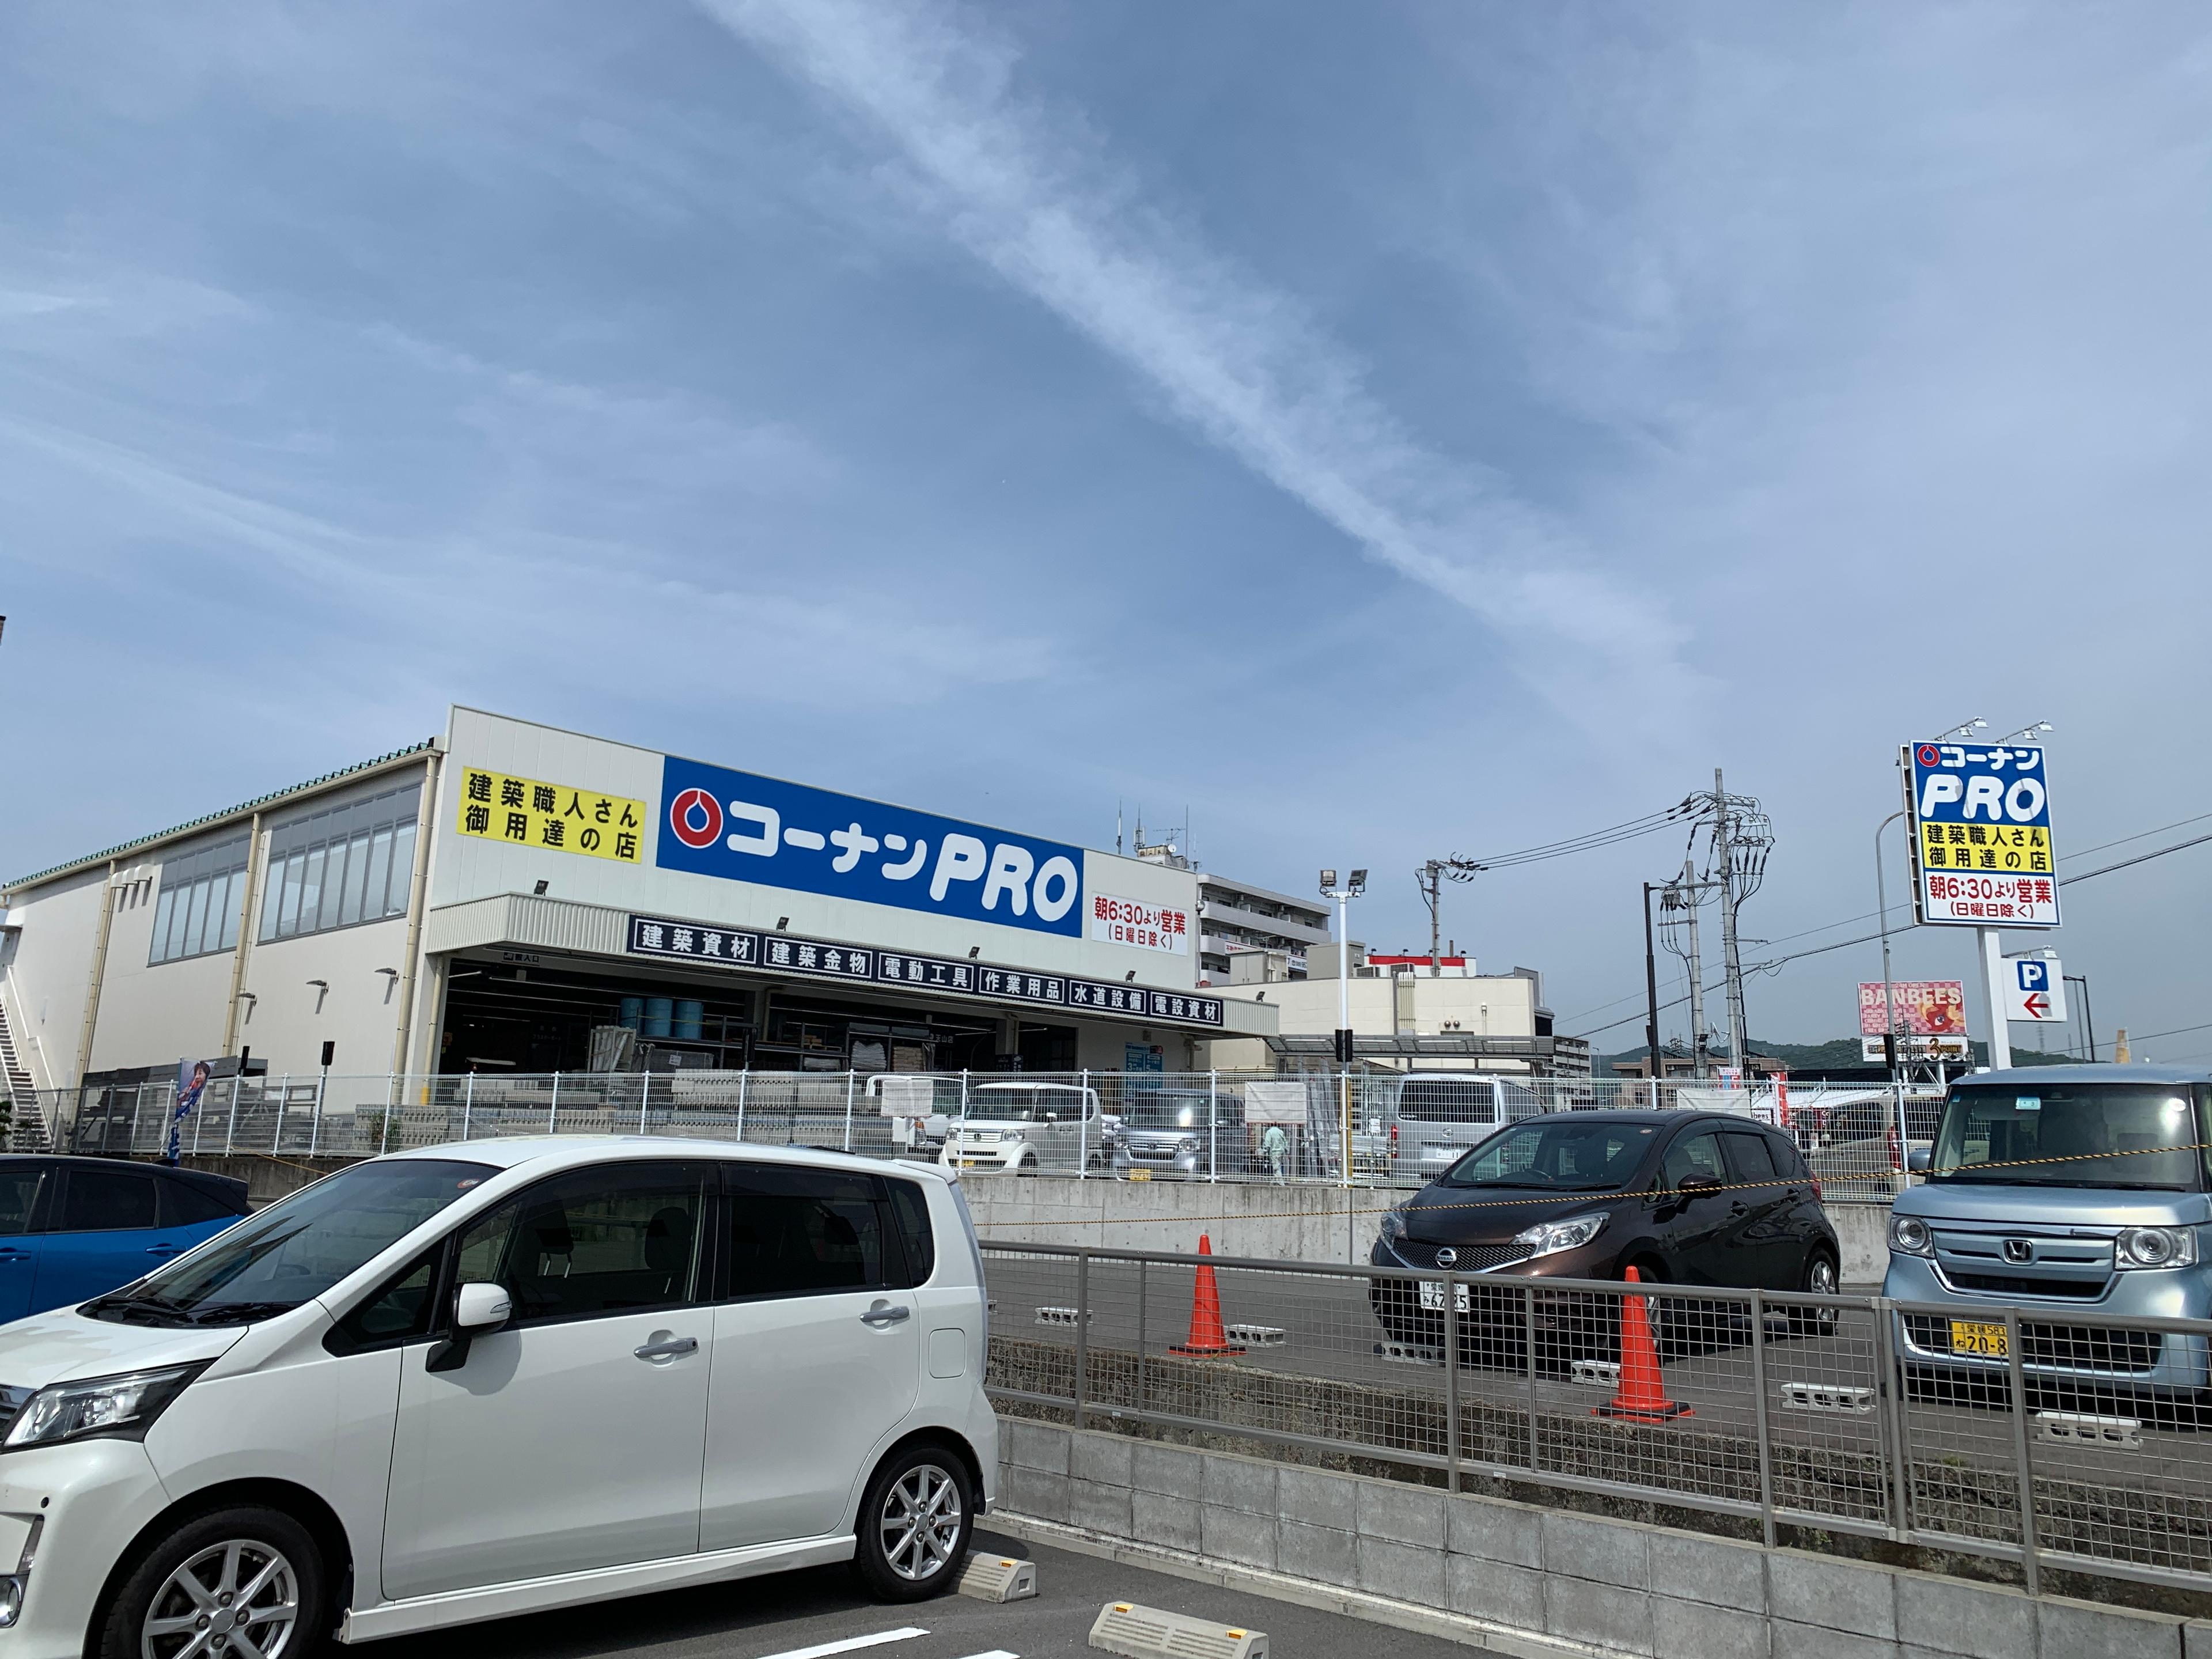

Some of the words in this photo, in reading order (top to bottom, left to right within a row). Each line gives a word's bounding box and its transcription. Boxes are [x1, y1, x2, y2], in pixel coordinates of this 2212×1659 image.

[1940, 747, 2039, 770] コーナン
[468, 773, 638, 828] 建築職人さん
[1921, 774, 2045, 822] PRO
[465, 804, 637, 859] 御用達の店
[1927, 824, 2044, 847] 建築職人さん
[727, 800, 927, 881] コーナン
[930, 833, 1078, 922] PRO
[1929, 847, 2047, 870] 御用達の店
[1929, 876, 2052, 904] 朝6:30より営業
[1095, 896, 1185, 935] 朝6:30より営業
[642, 925, 750, 959] 建築資材
[771, 942, 866, 974] 建築金物
[885, 957, 968, 987] 電動工具
[985, 972, 1059, 1000] 作業用品
[2022, 964, 2042, 987] P
[1074, 984, 1142, 1010] 水道設備
[1155, 995, 1217, 1021] 電設資材
[1861, 987, 1961, 1005] BANBEES
